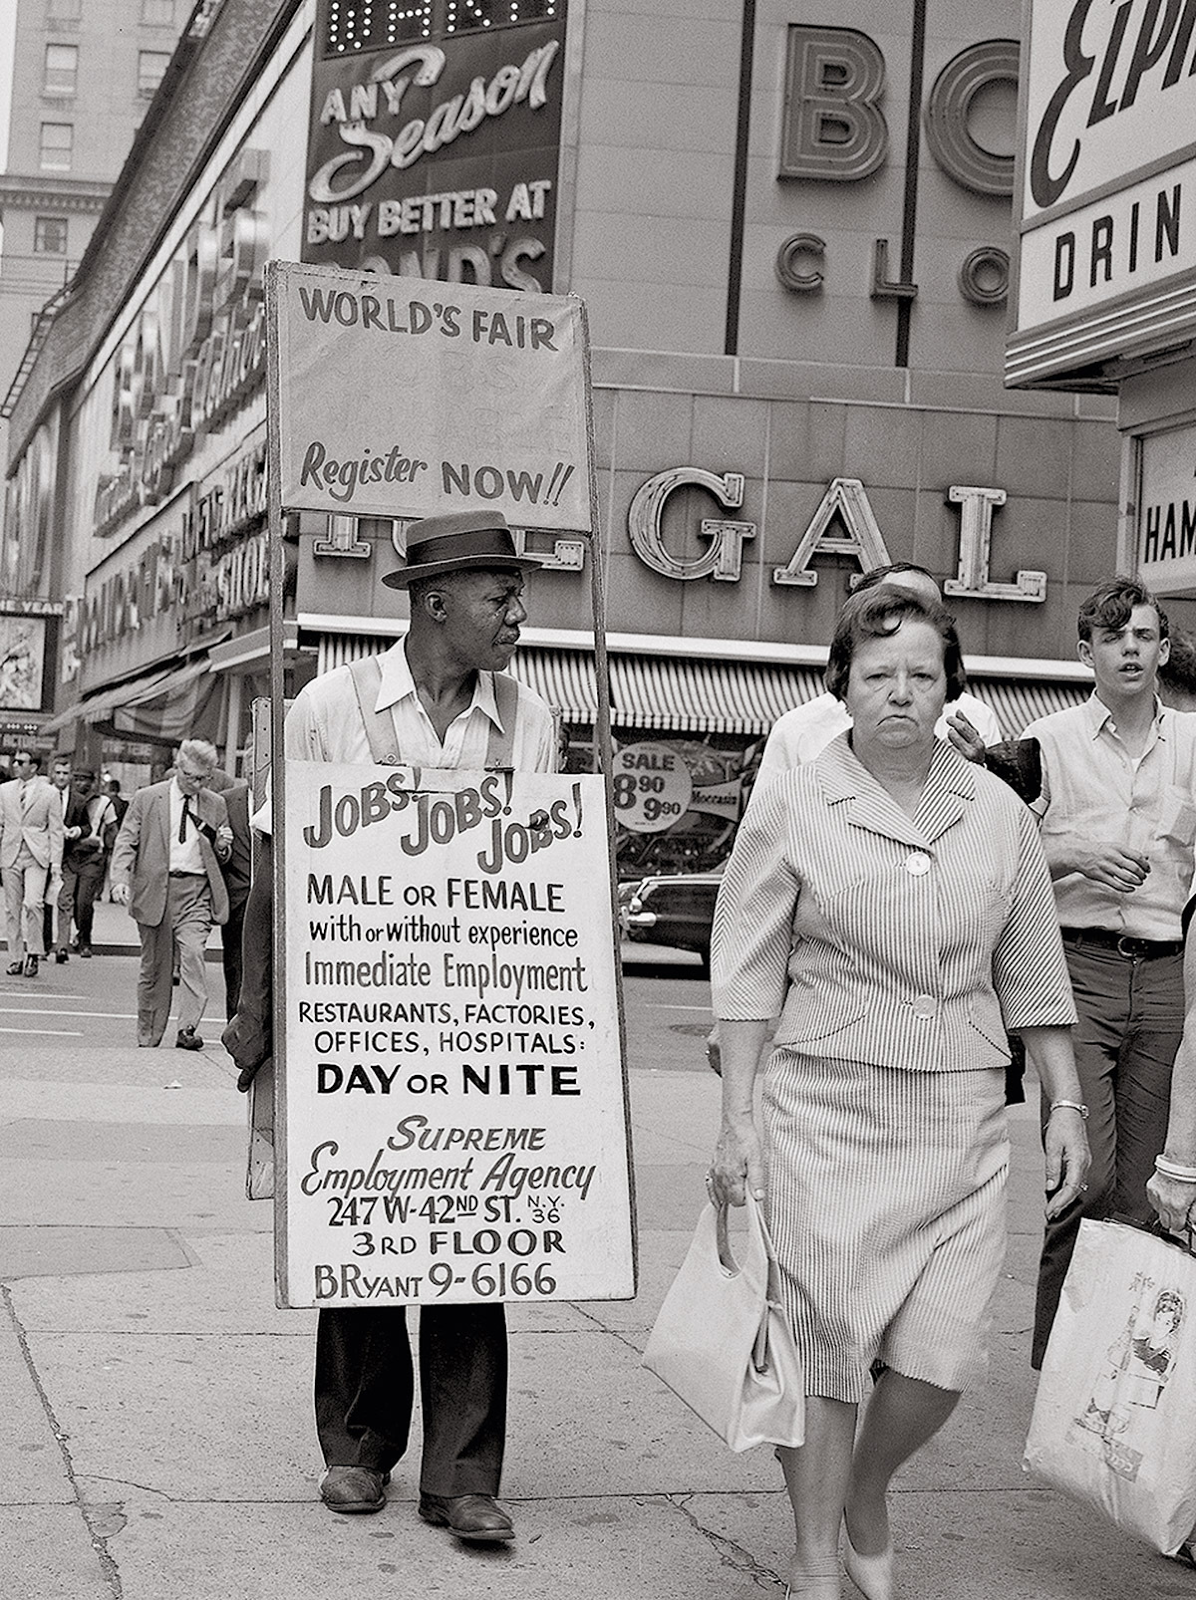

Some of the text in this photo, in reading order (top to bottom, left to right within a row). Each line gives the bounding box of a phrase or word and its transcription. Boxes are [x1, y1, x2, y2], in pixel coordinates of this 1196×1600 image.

[320, 77, 409, 125] ANY
[309, 40, 559, 203] Season
[307, 180, 551, 244] BUY BETTER AT
[299, 287, 559, 351] WORLD'S FAIR
[300, 441, 428, 502] Register
[441, 462, 575, 507] NOW!!
[21, 601, 64, 615] YEAR
[622, 753, 675, 772] SALE
[302, 765, 583, 875] JOBS! JOBS! JOBS!
[307, 873, 566, 913] MALE OR FEMALE
[309, 914, 579, 951] with or without experience
[305, 951, 589, 1000] Immediate Employment
[299, 1002, 596, 1029] RESTAURANTS, FACTORIES,
[314, 1031, 430, 1056] OFFICES,
[317, 1064, 582, 1096] DAY OR NITE
[387, 1115, 546, 1151] SUPREME
[300, 1141, 597, 1201] Employment Agency
[328, 1197, 379, 1226] 247
[484, 1196, 521, 1223] ST.
[532, 1209, 561, 1224] 36
[352, 1230, 566, 1256] 3RD FLOOR
[428, 1262, 557, 1297] 9-6166
